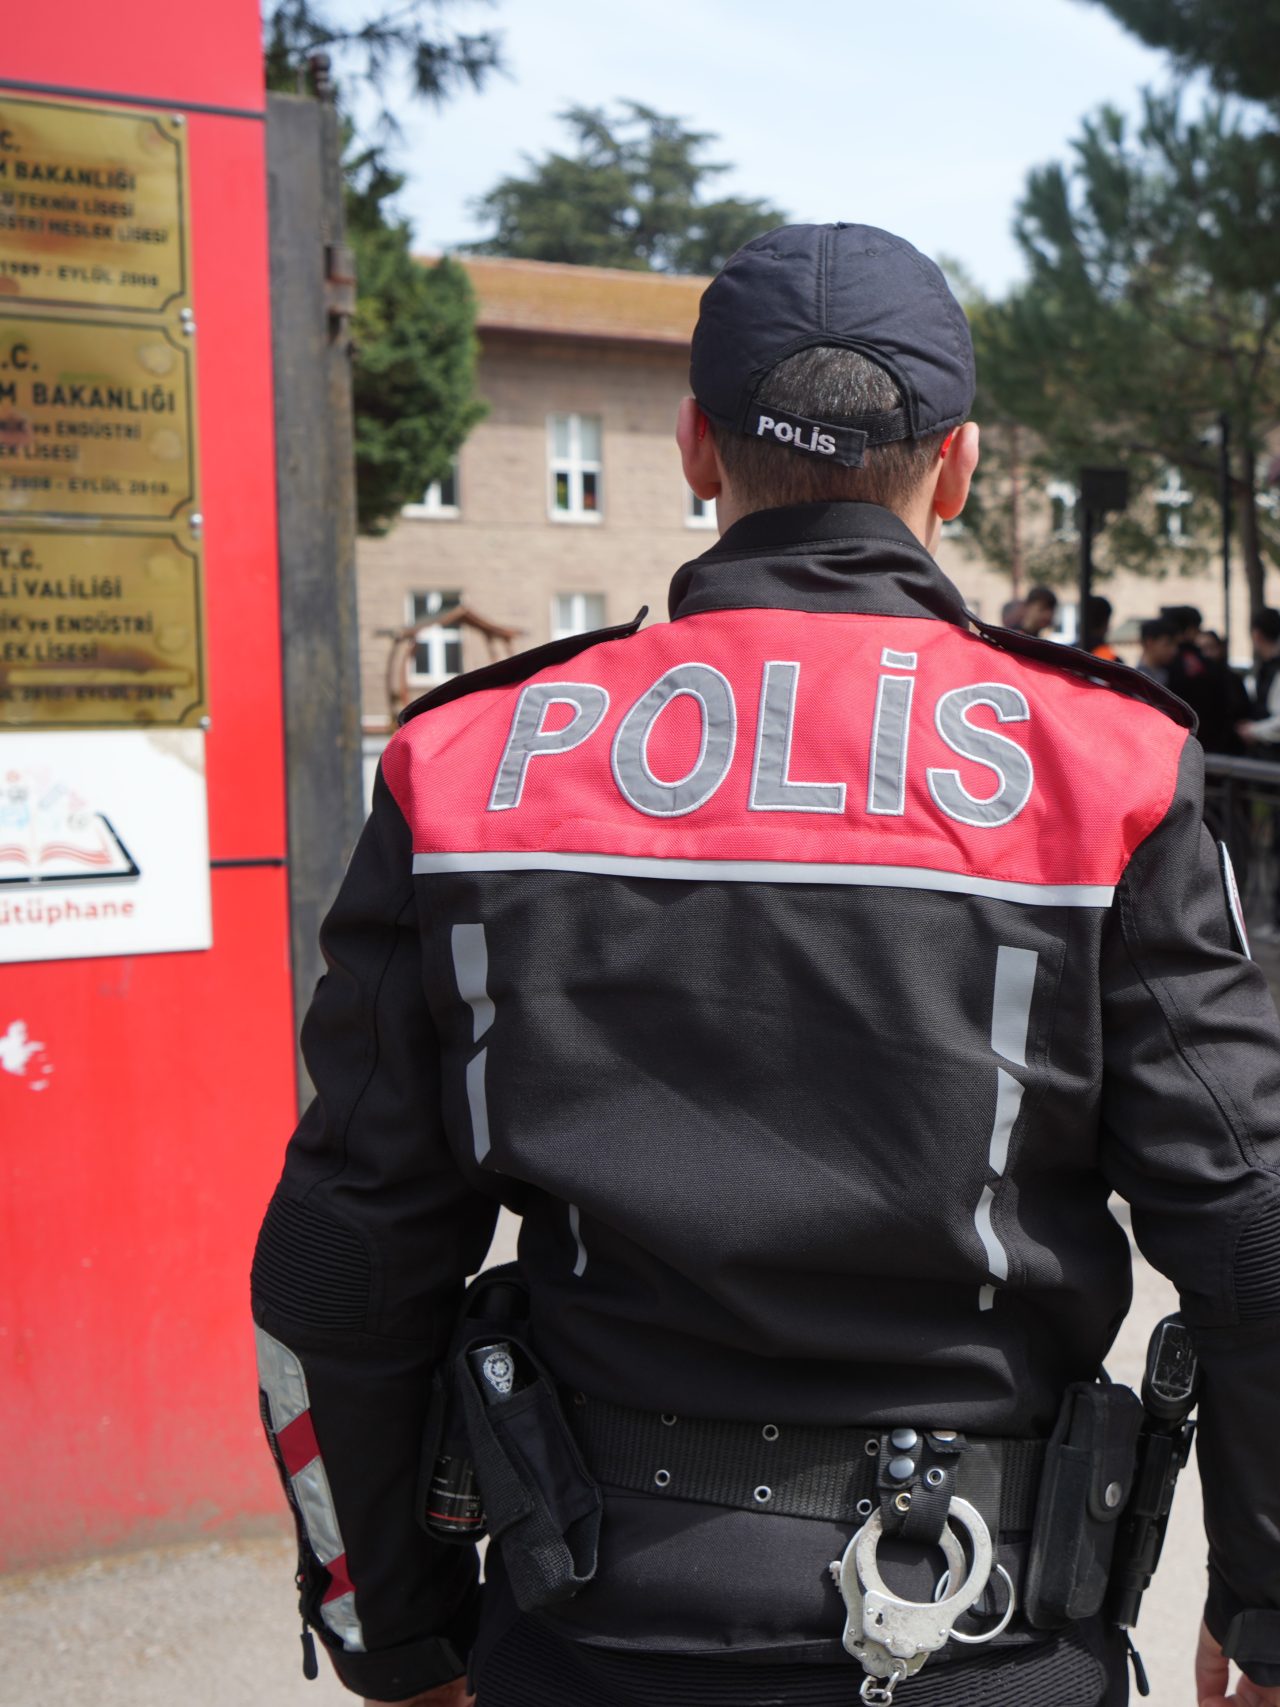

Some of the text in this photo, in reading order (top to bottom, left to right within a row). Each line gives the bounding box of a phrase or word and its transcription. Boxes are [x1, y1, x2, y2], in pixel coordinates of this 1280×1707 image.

[15, 161, 136, 191] BAKANLIĞI
[33, 382, 175, 413] BAKANLIĞI
[757, 415, 836, 455] POLİS
[24, 574, 122, 599] VALİLİĞİ
[55, 610, 153, 634] ENDÜSTRİ
[35, 638, 98, 662] LİSESİ
[487, 648, 1034, 829] POLİS
